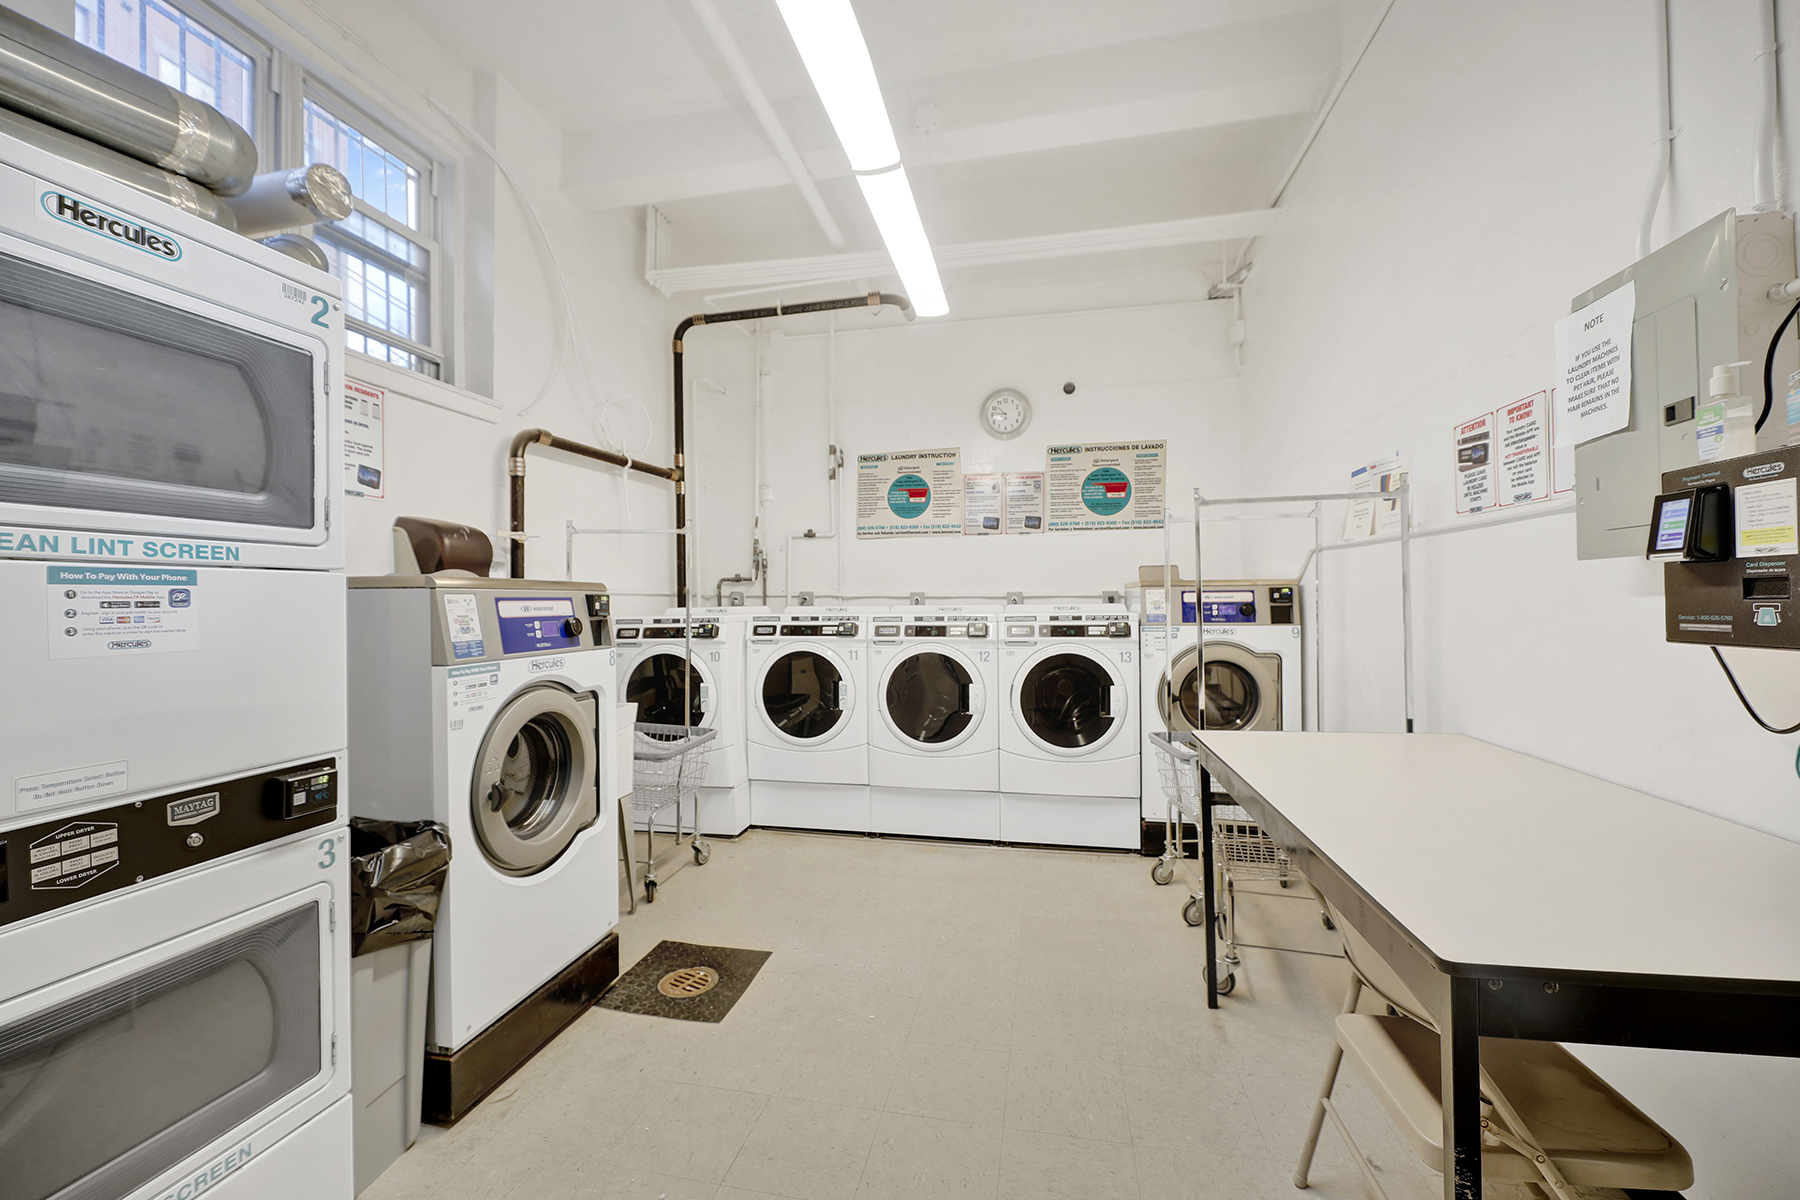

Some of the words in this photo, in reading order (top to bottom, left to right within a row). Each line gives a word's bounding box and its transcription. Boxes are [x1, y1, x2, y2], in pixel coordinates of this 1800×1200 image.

[56, 194, 175, 256] Hercules
[311, 295, 329, 330] 2
[1584, 313, 1604, 332] NOTE
[1581, 349, 1591, 358] YOU
[1592, 343, 1601, 353] USE
[1602, 338, 1611, 347] THE
[1568, 358, 1591, 374] LAUNDRY
[1592, 345, 1618, 363] MACHINES
[1575, 369, 1590, 381] CLEAN
[1591, 362, 1606, 373] ITEMS
[1607, 355, 1620, 366] WITH
[1573, 383, 1582, 391] PET
[1596, 368, 1614, 380] PLEASE
[1568, 392, 1583, 403] MAKE
[1584, 386, 1596, 397] SURE
[1597, 379, 1611, 391] THAT
[1507, 399, 1534, 416] IMPORTANT
[1567, 403, 1580, 413] HAIR
[1581, 394, 1603, 408] REMAINS
[1611, 386, 1620, 395] THE
[1516, 410, 1532, 421] KNOW!
[1461, 419, 1486, 435] ATTENTION
[1701, 470, 1721, 478] Terminal
[1746, 463, 1782, 475] Hercules
[71, 536, 134, 556] LINT
[142, 542, 240, 561] SCREEN
[98, 573, 114, 581] Pay
[1292, 627, 1299, 638] 9
[111, 640, 149, 648] Hercules
[609, 650, 615, 666] 8
[709, 652, 720, 662] 10
[848, 650, 858, 660] 11
[978, 651, 990, 662] 12
[1119, 652, 1132, 663] 13
[531, 658, 563, 670] Hercules
[174, 799, 214, 814] MAYTAG
[55, 831, 75, 839] UPPER
[76, 826, 95, 834] DRYER
[317, 838, 336, 870] 3
[56, 874, 78, 885] LOWER
[78, 869, 98, 878] DRYER
[164, 1142, 252, 1200] CREEN
